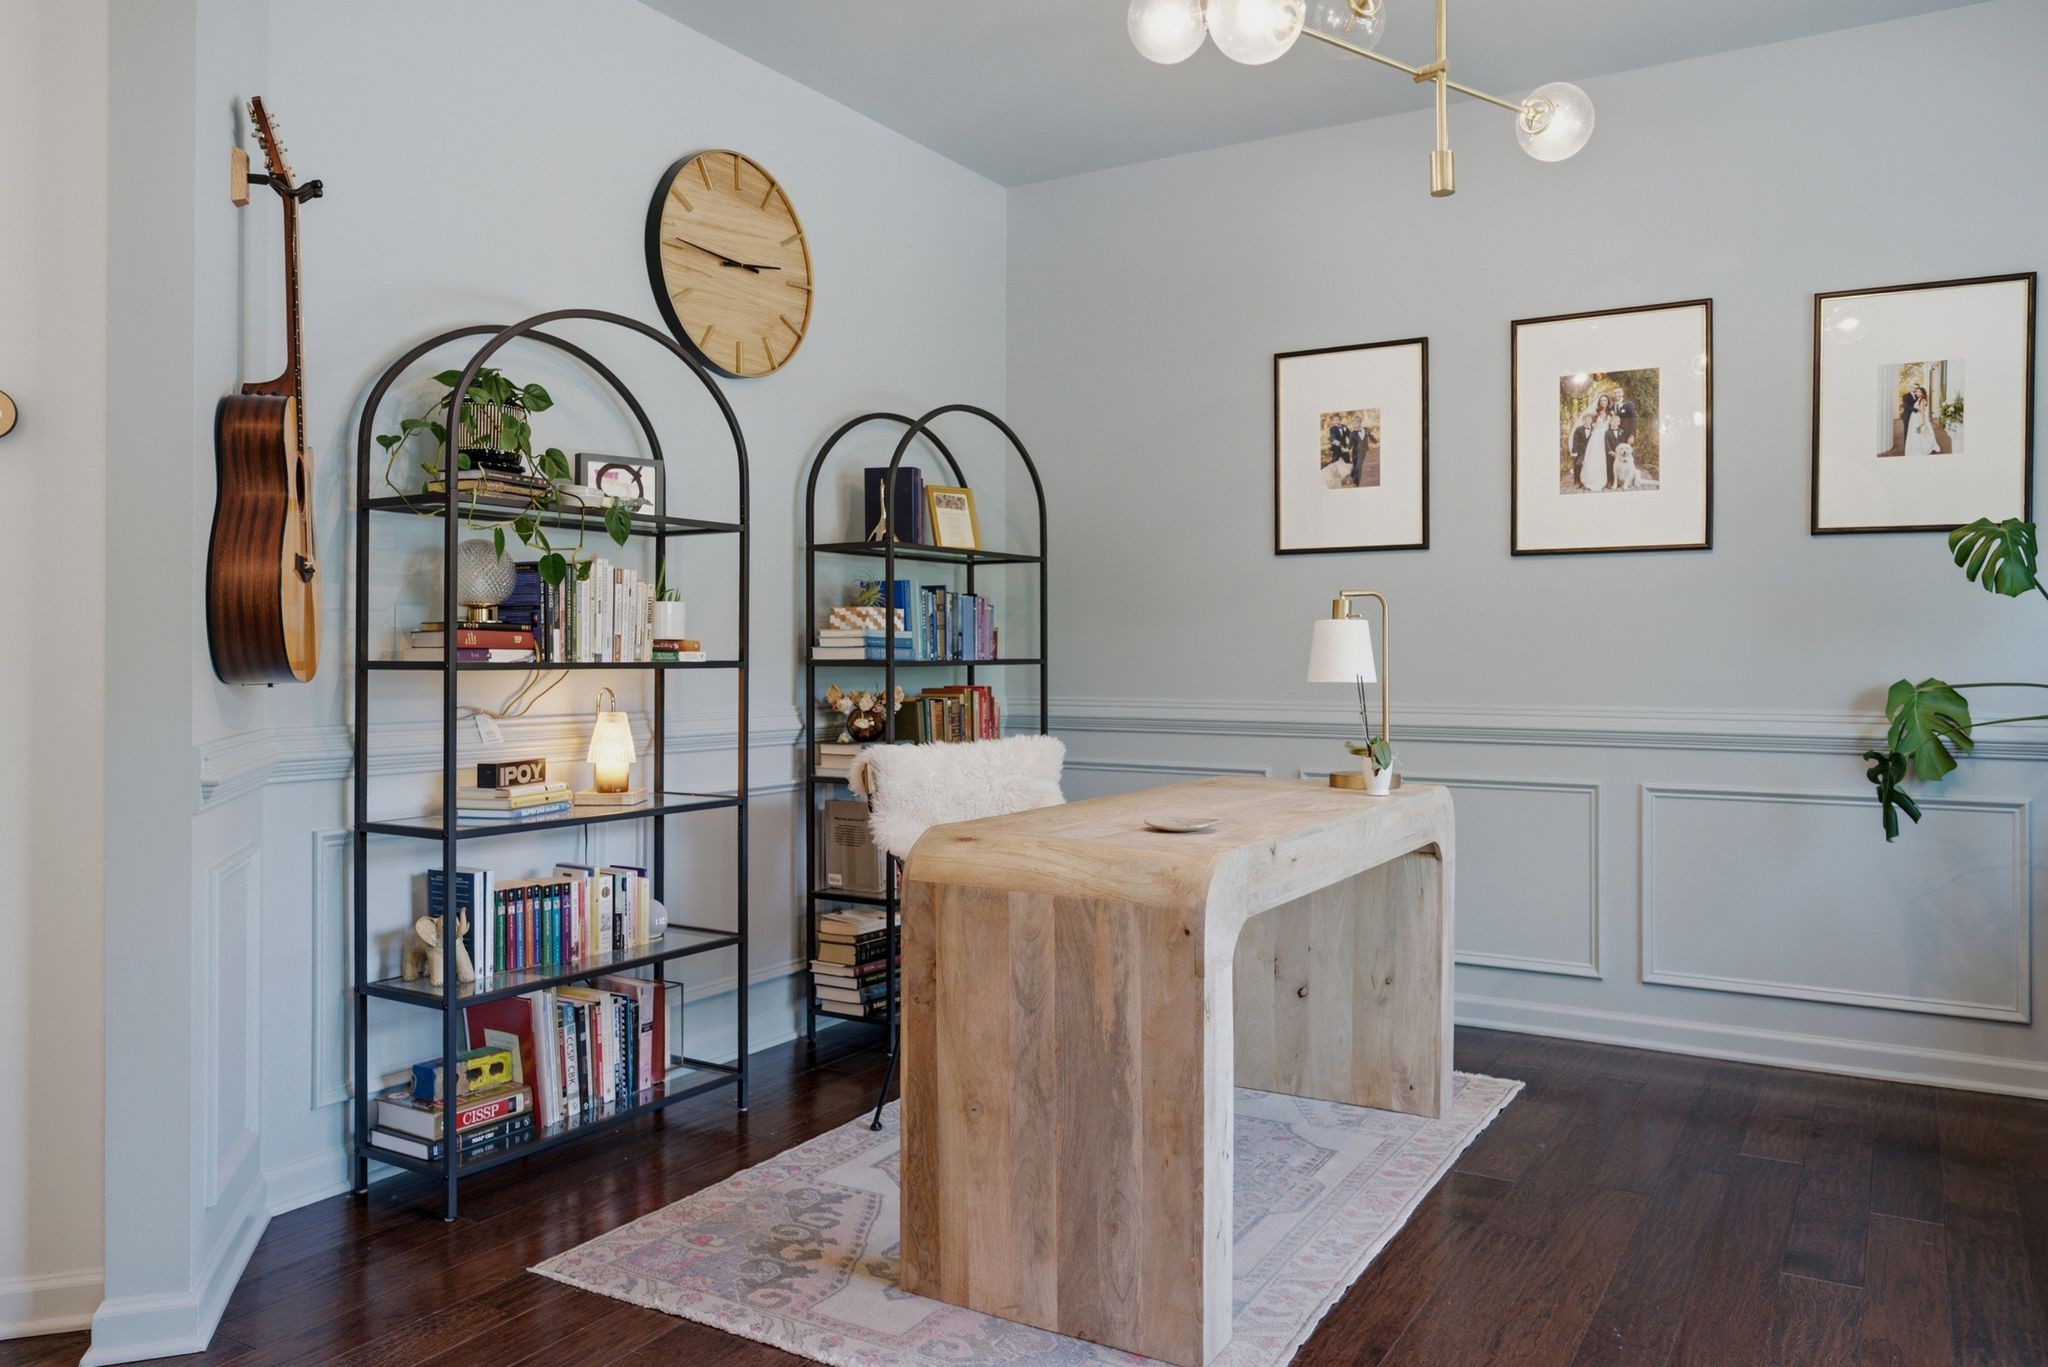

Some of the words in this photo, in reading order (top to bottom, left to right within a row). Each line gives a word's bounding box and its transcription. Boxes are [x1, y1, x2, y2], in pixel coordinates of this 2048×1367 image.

[500, 764, 543, 786] IPOY
[566, 1036, 575, 1061] CCSP
[567, 1065, 575, 1086] CBK
[462, 1104, 499, 1126] CISSP
